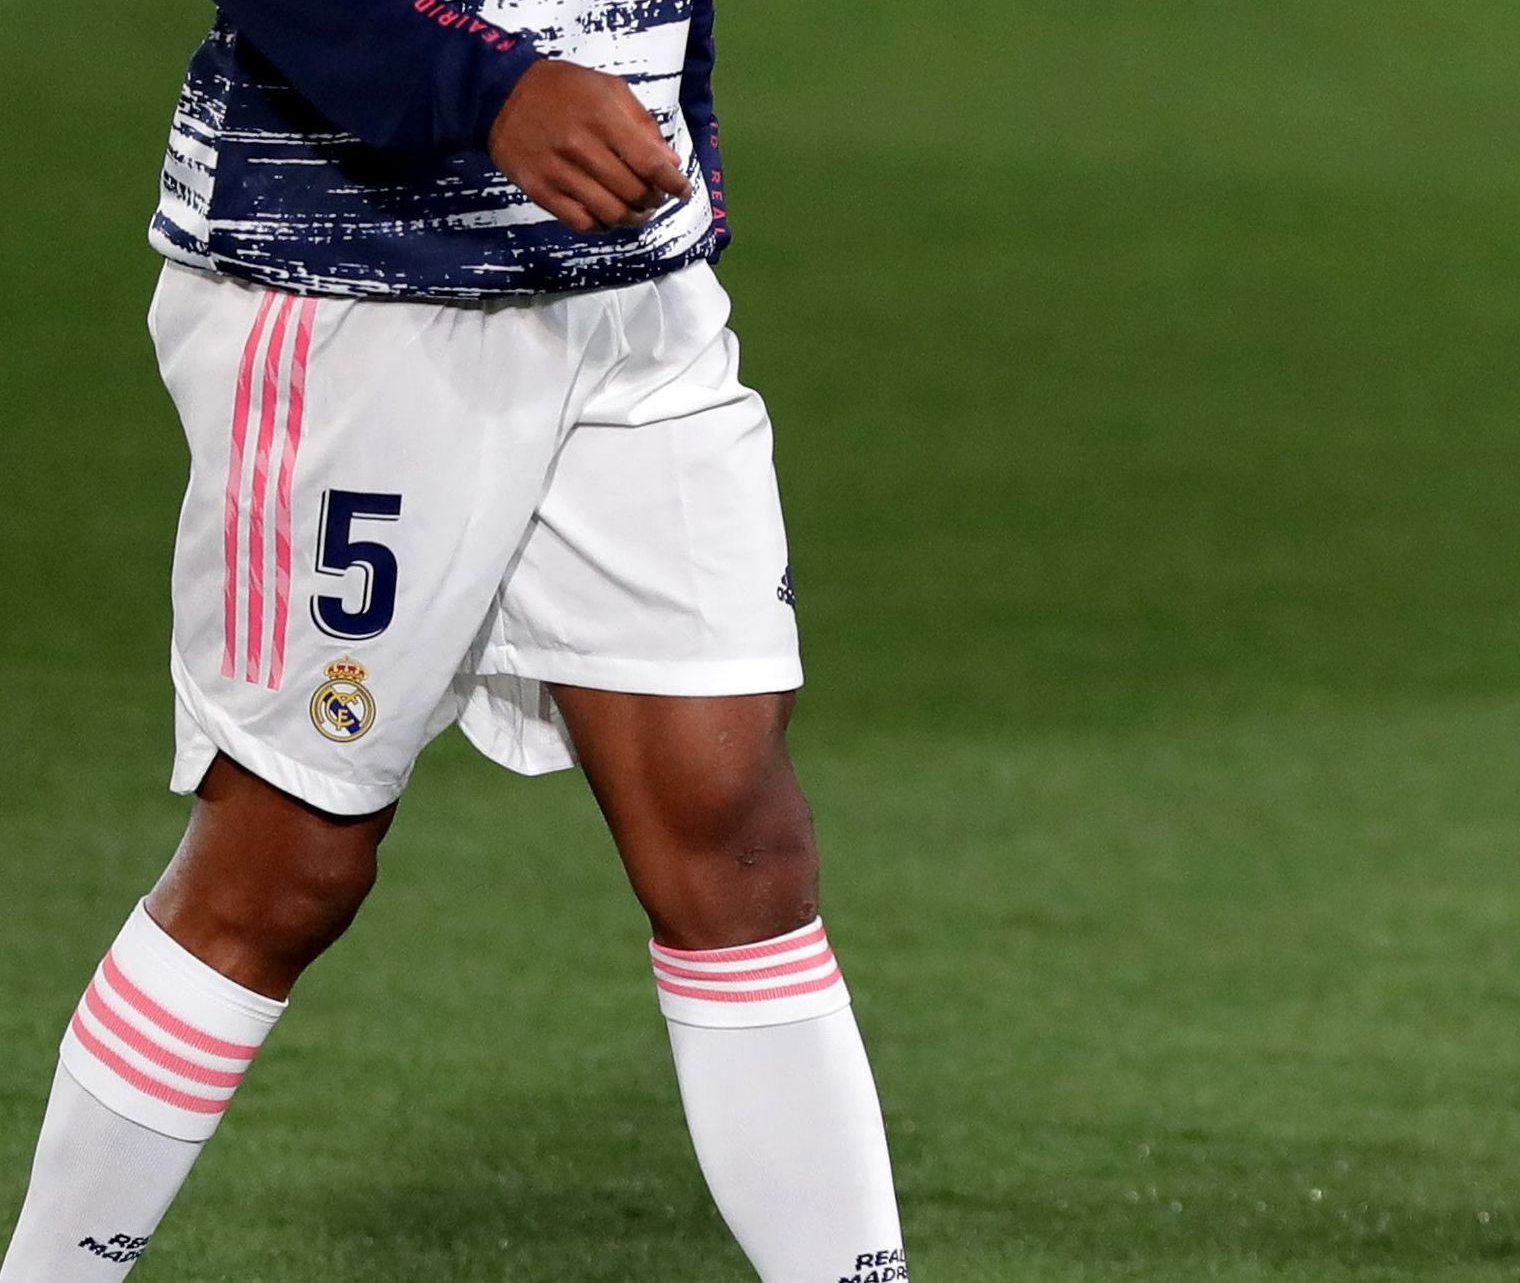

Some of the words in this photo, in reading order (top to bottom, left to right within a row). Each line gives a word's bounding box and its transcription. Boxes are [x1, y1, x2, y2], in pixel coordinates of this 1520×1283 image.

[710, 170, 727, 236] REAL
[309, 487, 403, 642] 5
[855, 1248, 906, 1271] REAL
